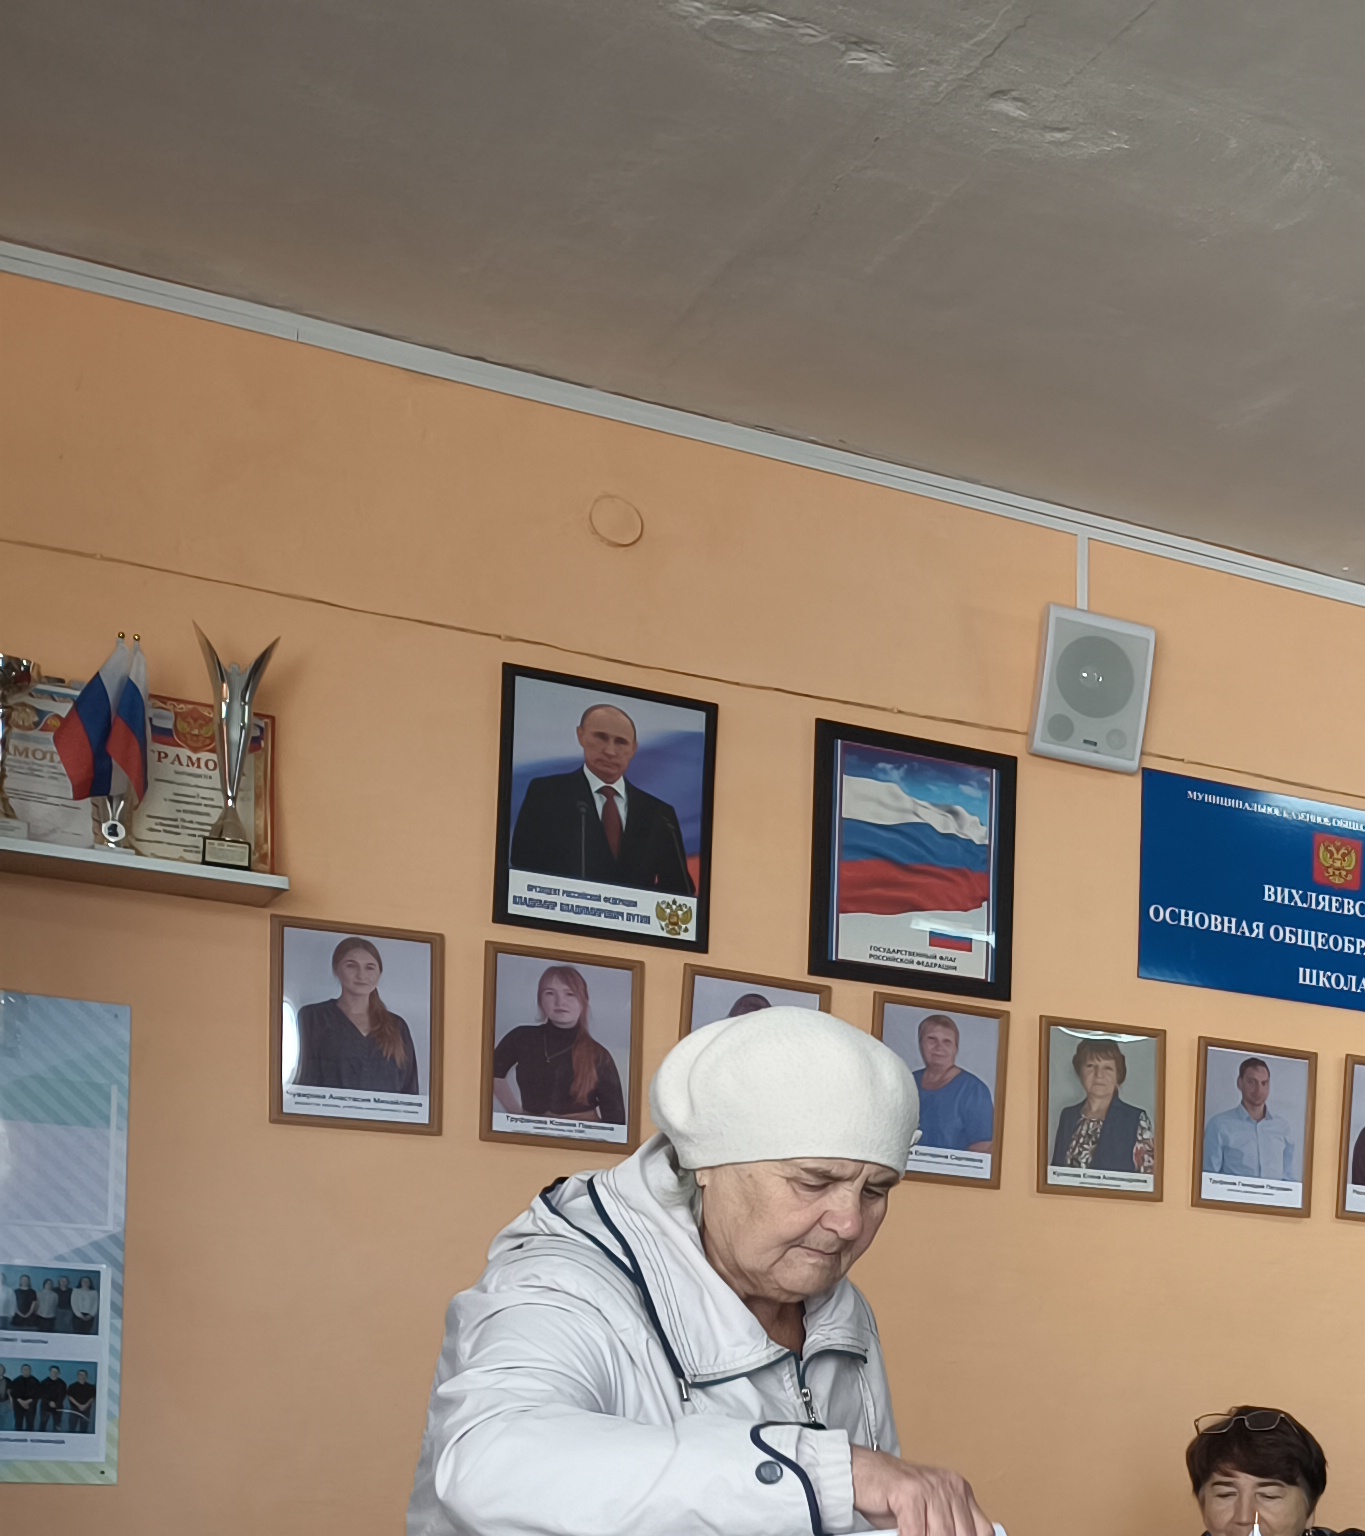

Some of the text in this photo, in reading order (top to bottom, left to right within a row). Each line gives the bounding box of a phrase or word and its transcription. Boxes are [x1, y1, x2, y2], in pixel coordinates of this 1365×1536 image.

[150, 749, 218, 771] РАМО
[1149, 904, 1265, 940] ОСНОВНАЯ
[869, 953, 914, 965] РОССИЙСКОЙ
